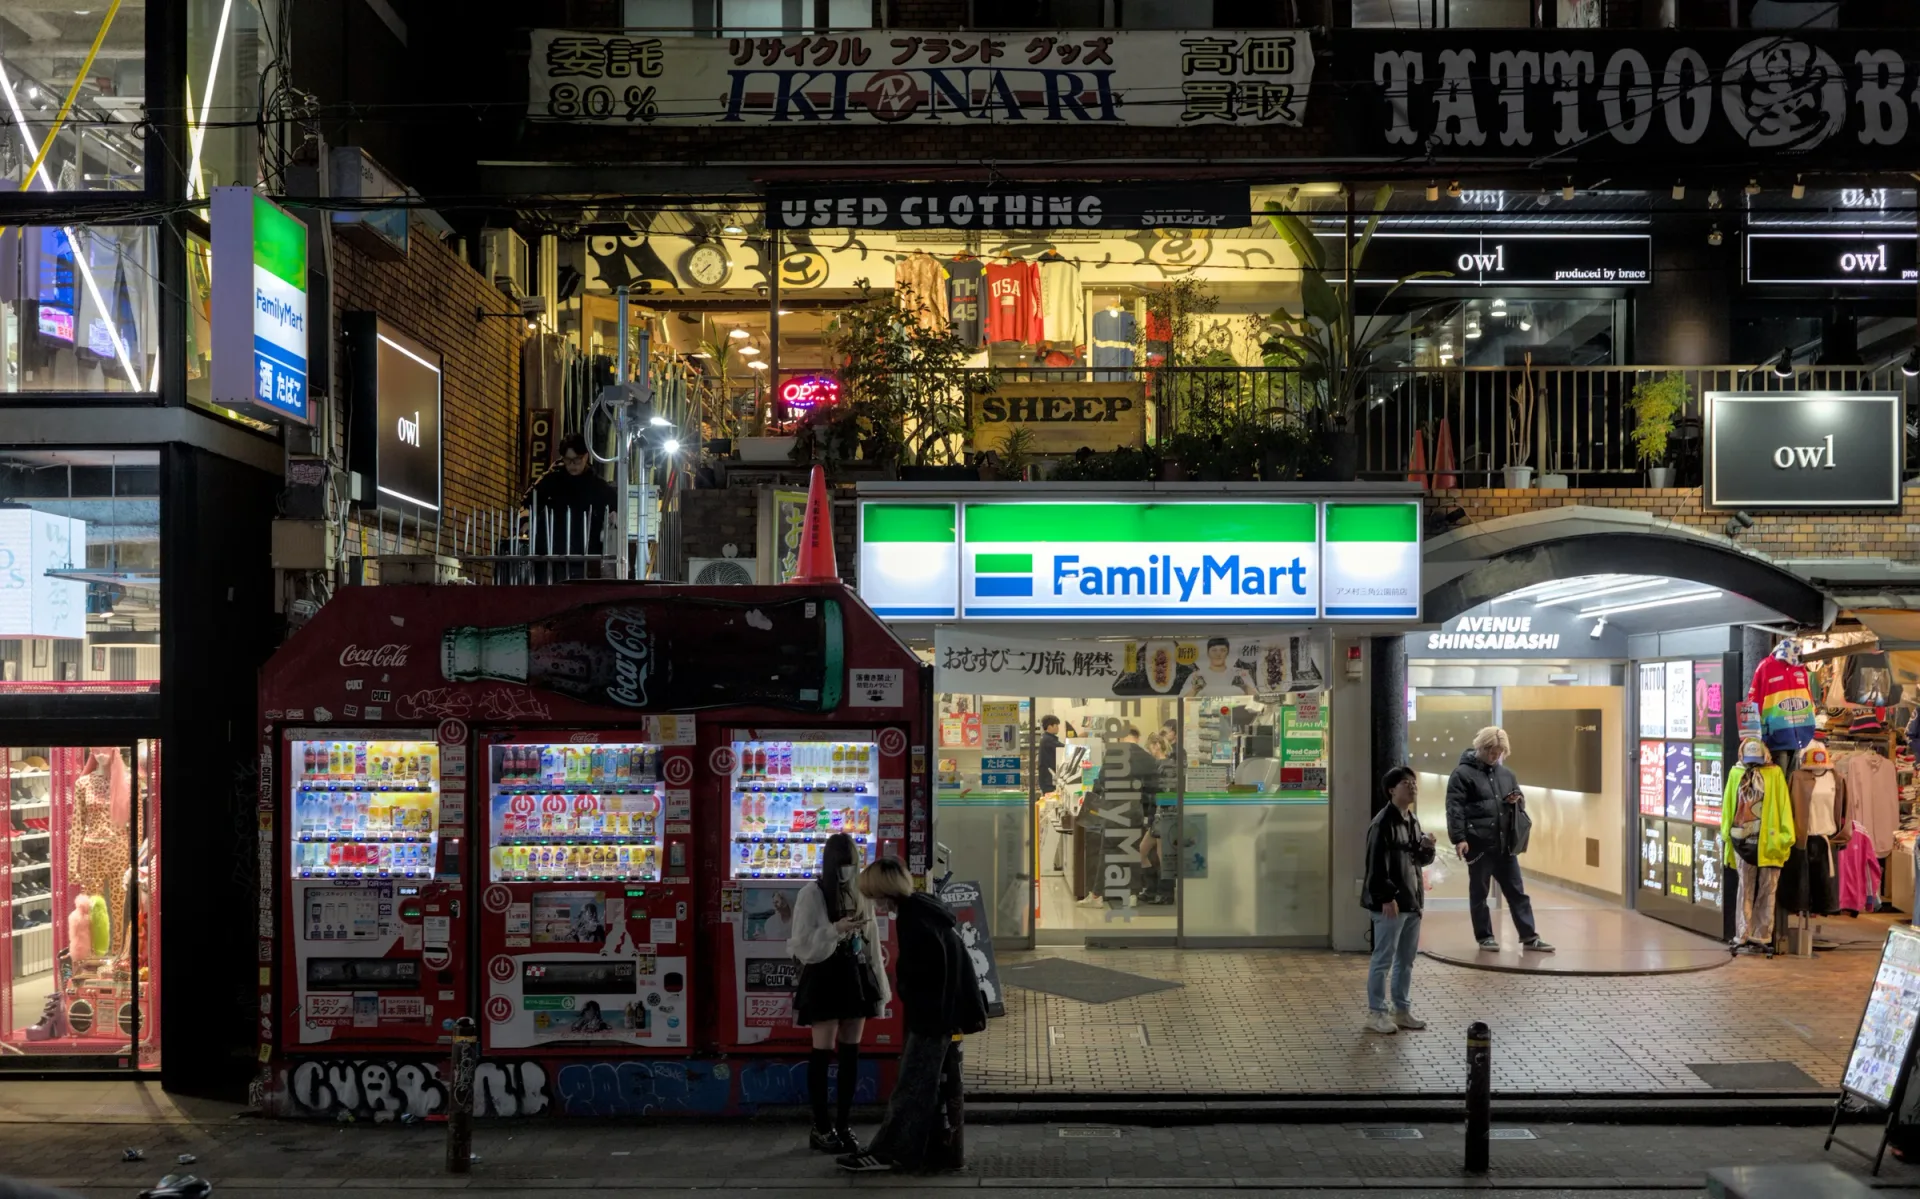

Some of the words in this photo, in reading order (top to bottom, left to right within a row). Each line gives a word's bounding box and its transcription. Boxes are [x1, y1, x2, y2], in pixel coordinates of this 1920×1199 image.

[547, 36, 664, 79] 委託
[727, 36, 872, 66] リサイクル
[891, 36, 1006, 66] ブランド
[1025, 36, 1114, 66] グッズ
[1180, 36, 1295, 76] 高価
[548, 82, 660, 121] 80%
[1180, 80, 1296, 121] 買取
[1373, 47, 1713, 148] TATTOO
[1856, 50, 1920, 148] B
[781, 196, 889, 227] USED
[900, 194, 1104, 227] CLOTHING
[1141, 209, 1227, 227] SHEEP
[1458, 245, 1505, 272] owl
[1840, 245, 1887, 272] owl
[992, 278, 1021, 298] USA
[1555, 268, 1602, 280] produced
[1603, 268, 1616, 281] by
[1618, 268, 1646, 279] brace
[256, 289, 303, 332] FamilyMart
[953, 304, 978, 321] 45
[259, 360, 273, 401] 酒
[275, 374, 302, 408] たばこ
[982, 397, 1133, 422] SHEEP
[398, 411, 421, 448] owl
[532, 420, 549, 479] OPE
[1774, 435, 1836, 469] owl
[1053, 555, 1307, 602] FamilyMart
[1456, 616, 1532, 632] AVENUE
[1428, 633, 1560, 650] SHINSAIBASHI
[340, 643, 412, 668] Coca-Cola
[942, 646, 1118, 678] おむすび二刀流、解禁。
[372, 691, 390, 701] CULT
[987, 759, 1015, 768] たばこ
[987, 775, 997, 784] お
[1099, 698, 1144, 924] FamilyMart
[941, 891, 980, 903] SHEEP
[766, 975, 784, 985] CULT
[312, 1005, 349, 1015] スタンプ
[752, 1006, 788, 1016] スタンプ
